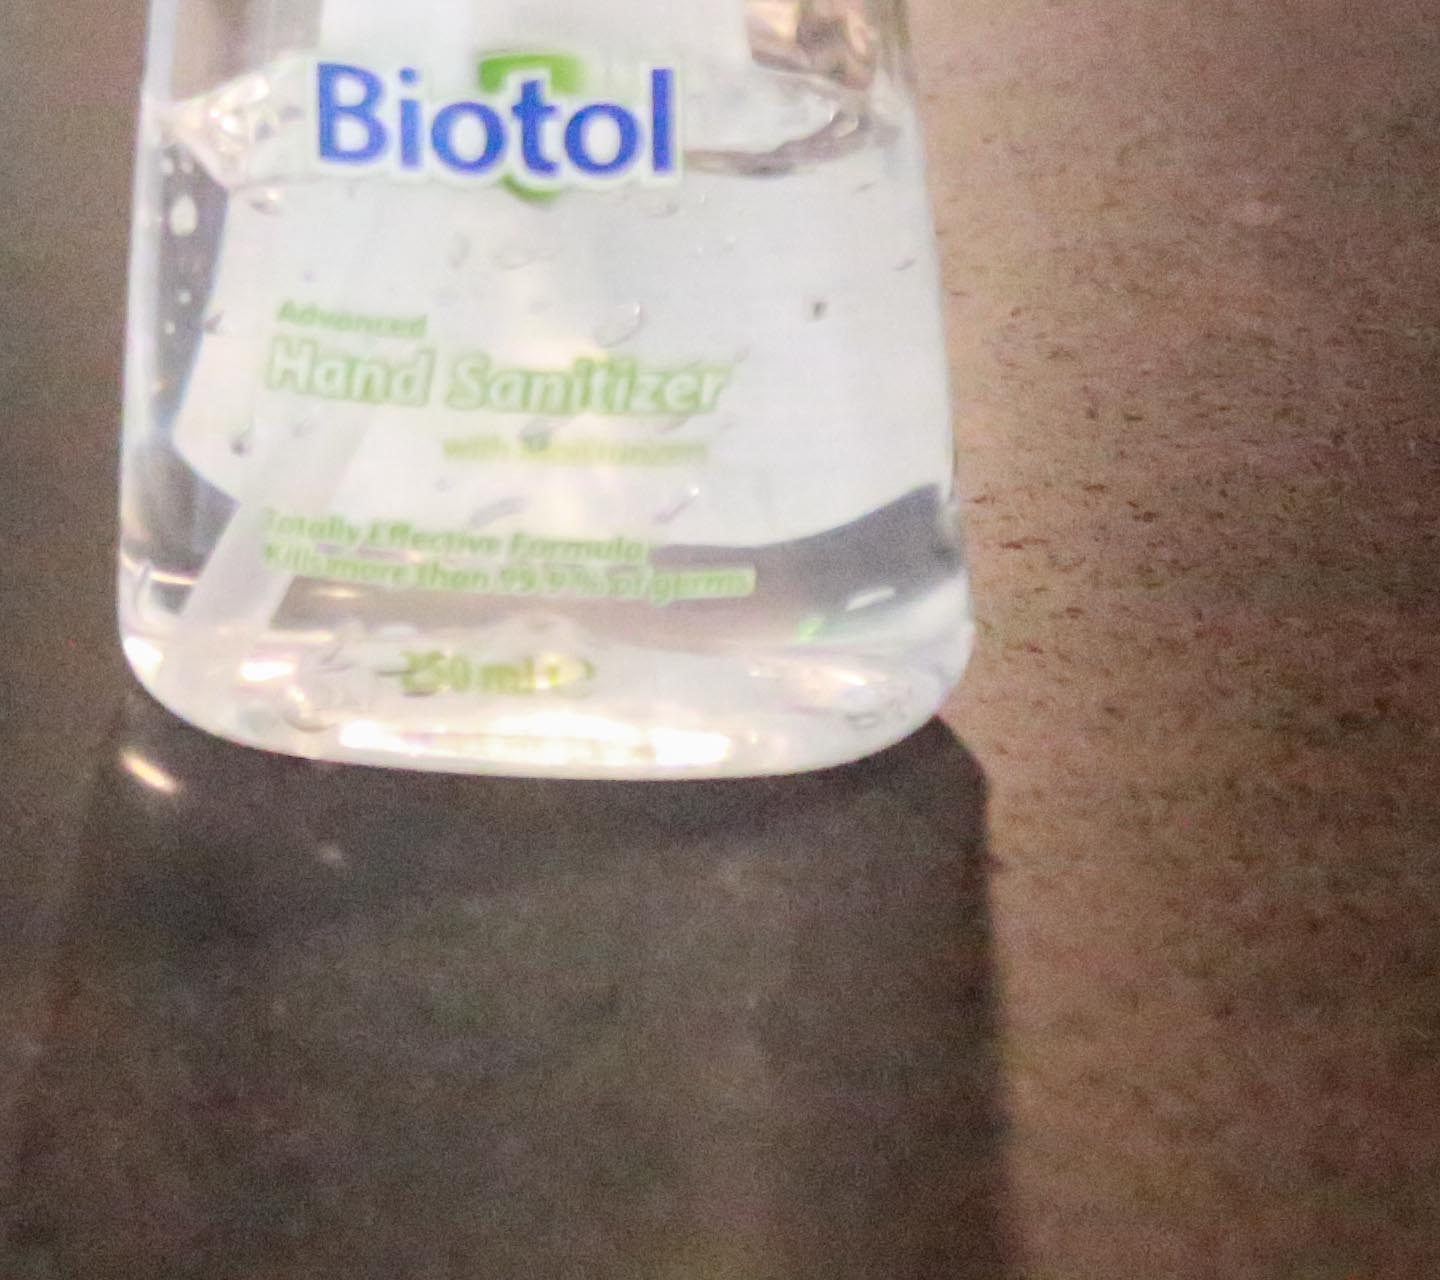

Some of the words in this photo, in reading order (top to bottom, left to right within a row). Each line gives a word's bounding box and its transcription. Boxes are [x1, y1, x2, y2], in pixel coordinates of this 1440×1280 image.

[316, 61, 676, 178] Biotol
[276, 299, 429, 339] Advanced
[267, 336, 435, 407] Hand
[445, 351, 731, 416] Sanitizer
[369, 517, 503, 554] Effective
[510, 531, 648, 564] Formula
[326, 557, 410, 587] more
[417, 557, 490, 590] than
[650, 566, 755, 607] germs
